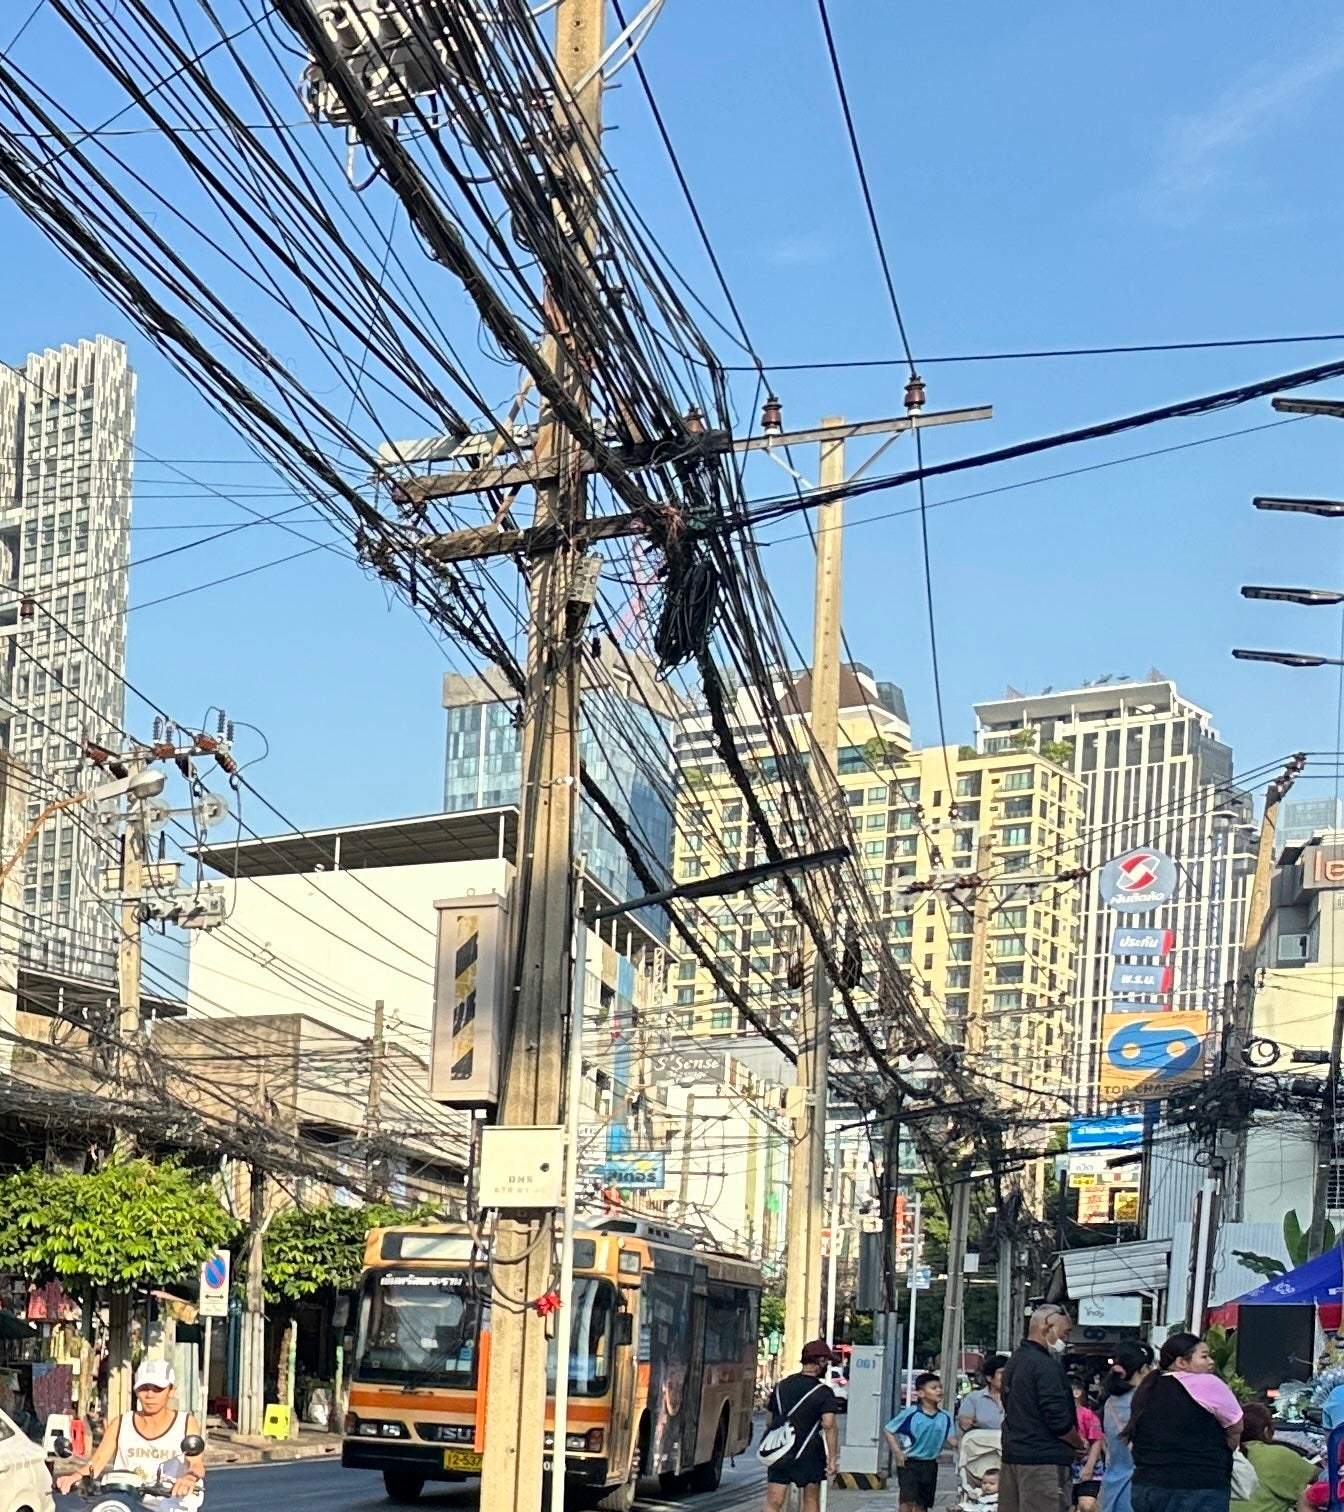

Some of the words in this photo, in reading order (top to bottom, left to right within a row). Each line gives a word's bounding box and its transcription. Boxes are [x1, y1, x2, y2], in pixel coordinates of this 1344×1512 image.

[1119, 935, 1159, 949] ประกัน
[437, 1426, 476, 1441] ISU
